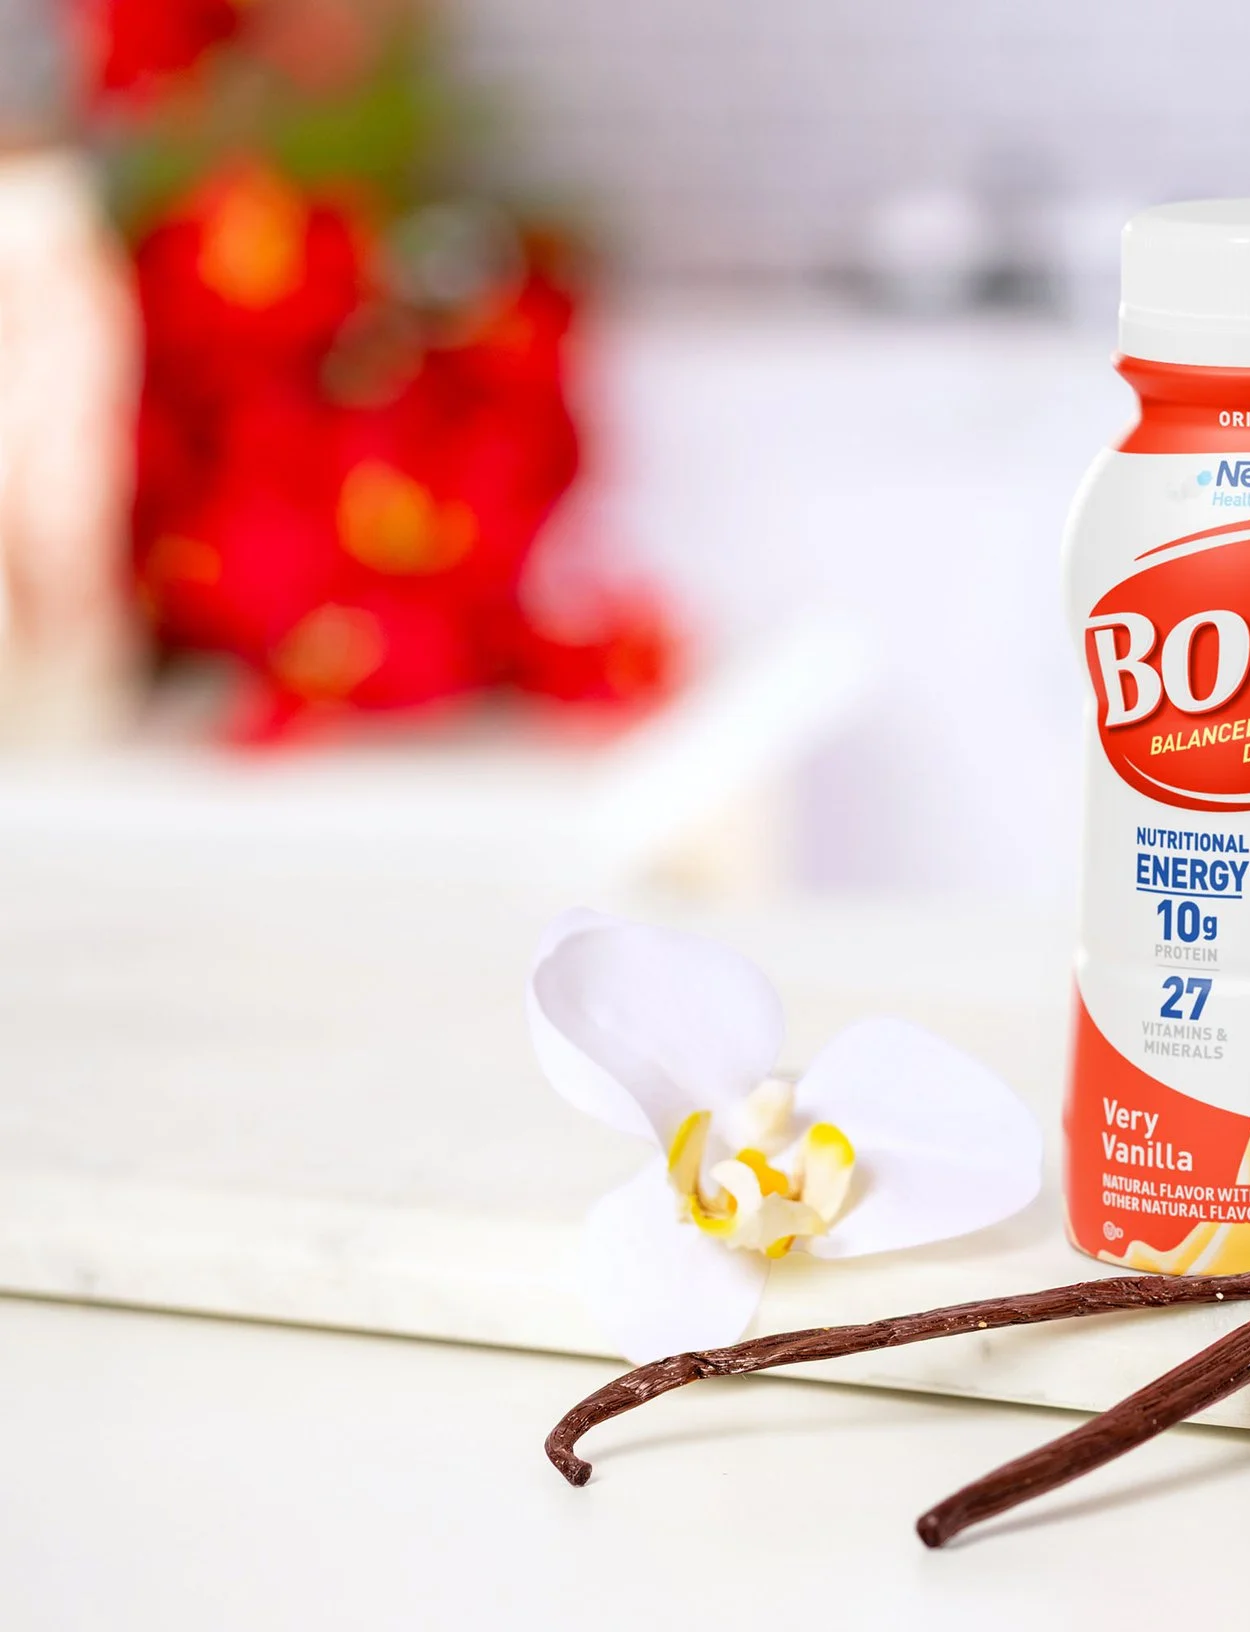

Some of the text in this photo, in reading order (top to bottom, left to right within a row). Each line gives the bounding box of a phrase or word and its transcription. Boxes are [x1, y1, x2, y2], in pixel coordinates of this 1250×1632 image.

[1136, 826, 1250, 853] NUTRITIONAL
[1136, 853, 1249, 892] ENERGY
[1157, 899, 1218, 943] 10g
[1155, 944, 1218, 962] PROTEIN
[1160, 975, 1213, 1021] 27
[1142, 1021, 1228, 1042] VITAMINS &
[1144, 1040, 1224, 1060] MINERALS
[1103, 1097, 1159, 1139] Very
[1103, 1132, 1193, 1172] Vanilla
[1103, 1173, 1157, 1197] NATURAL
[1160, 1183, 1215, 1202] FLAVOR
[1103, 1191, 1140, 1212] OTHER
[1142, 1200, 1207, 1219] NATURAL
